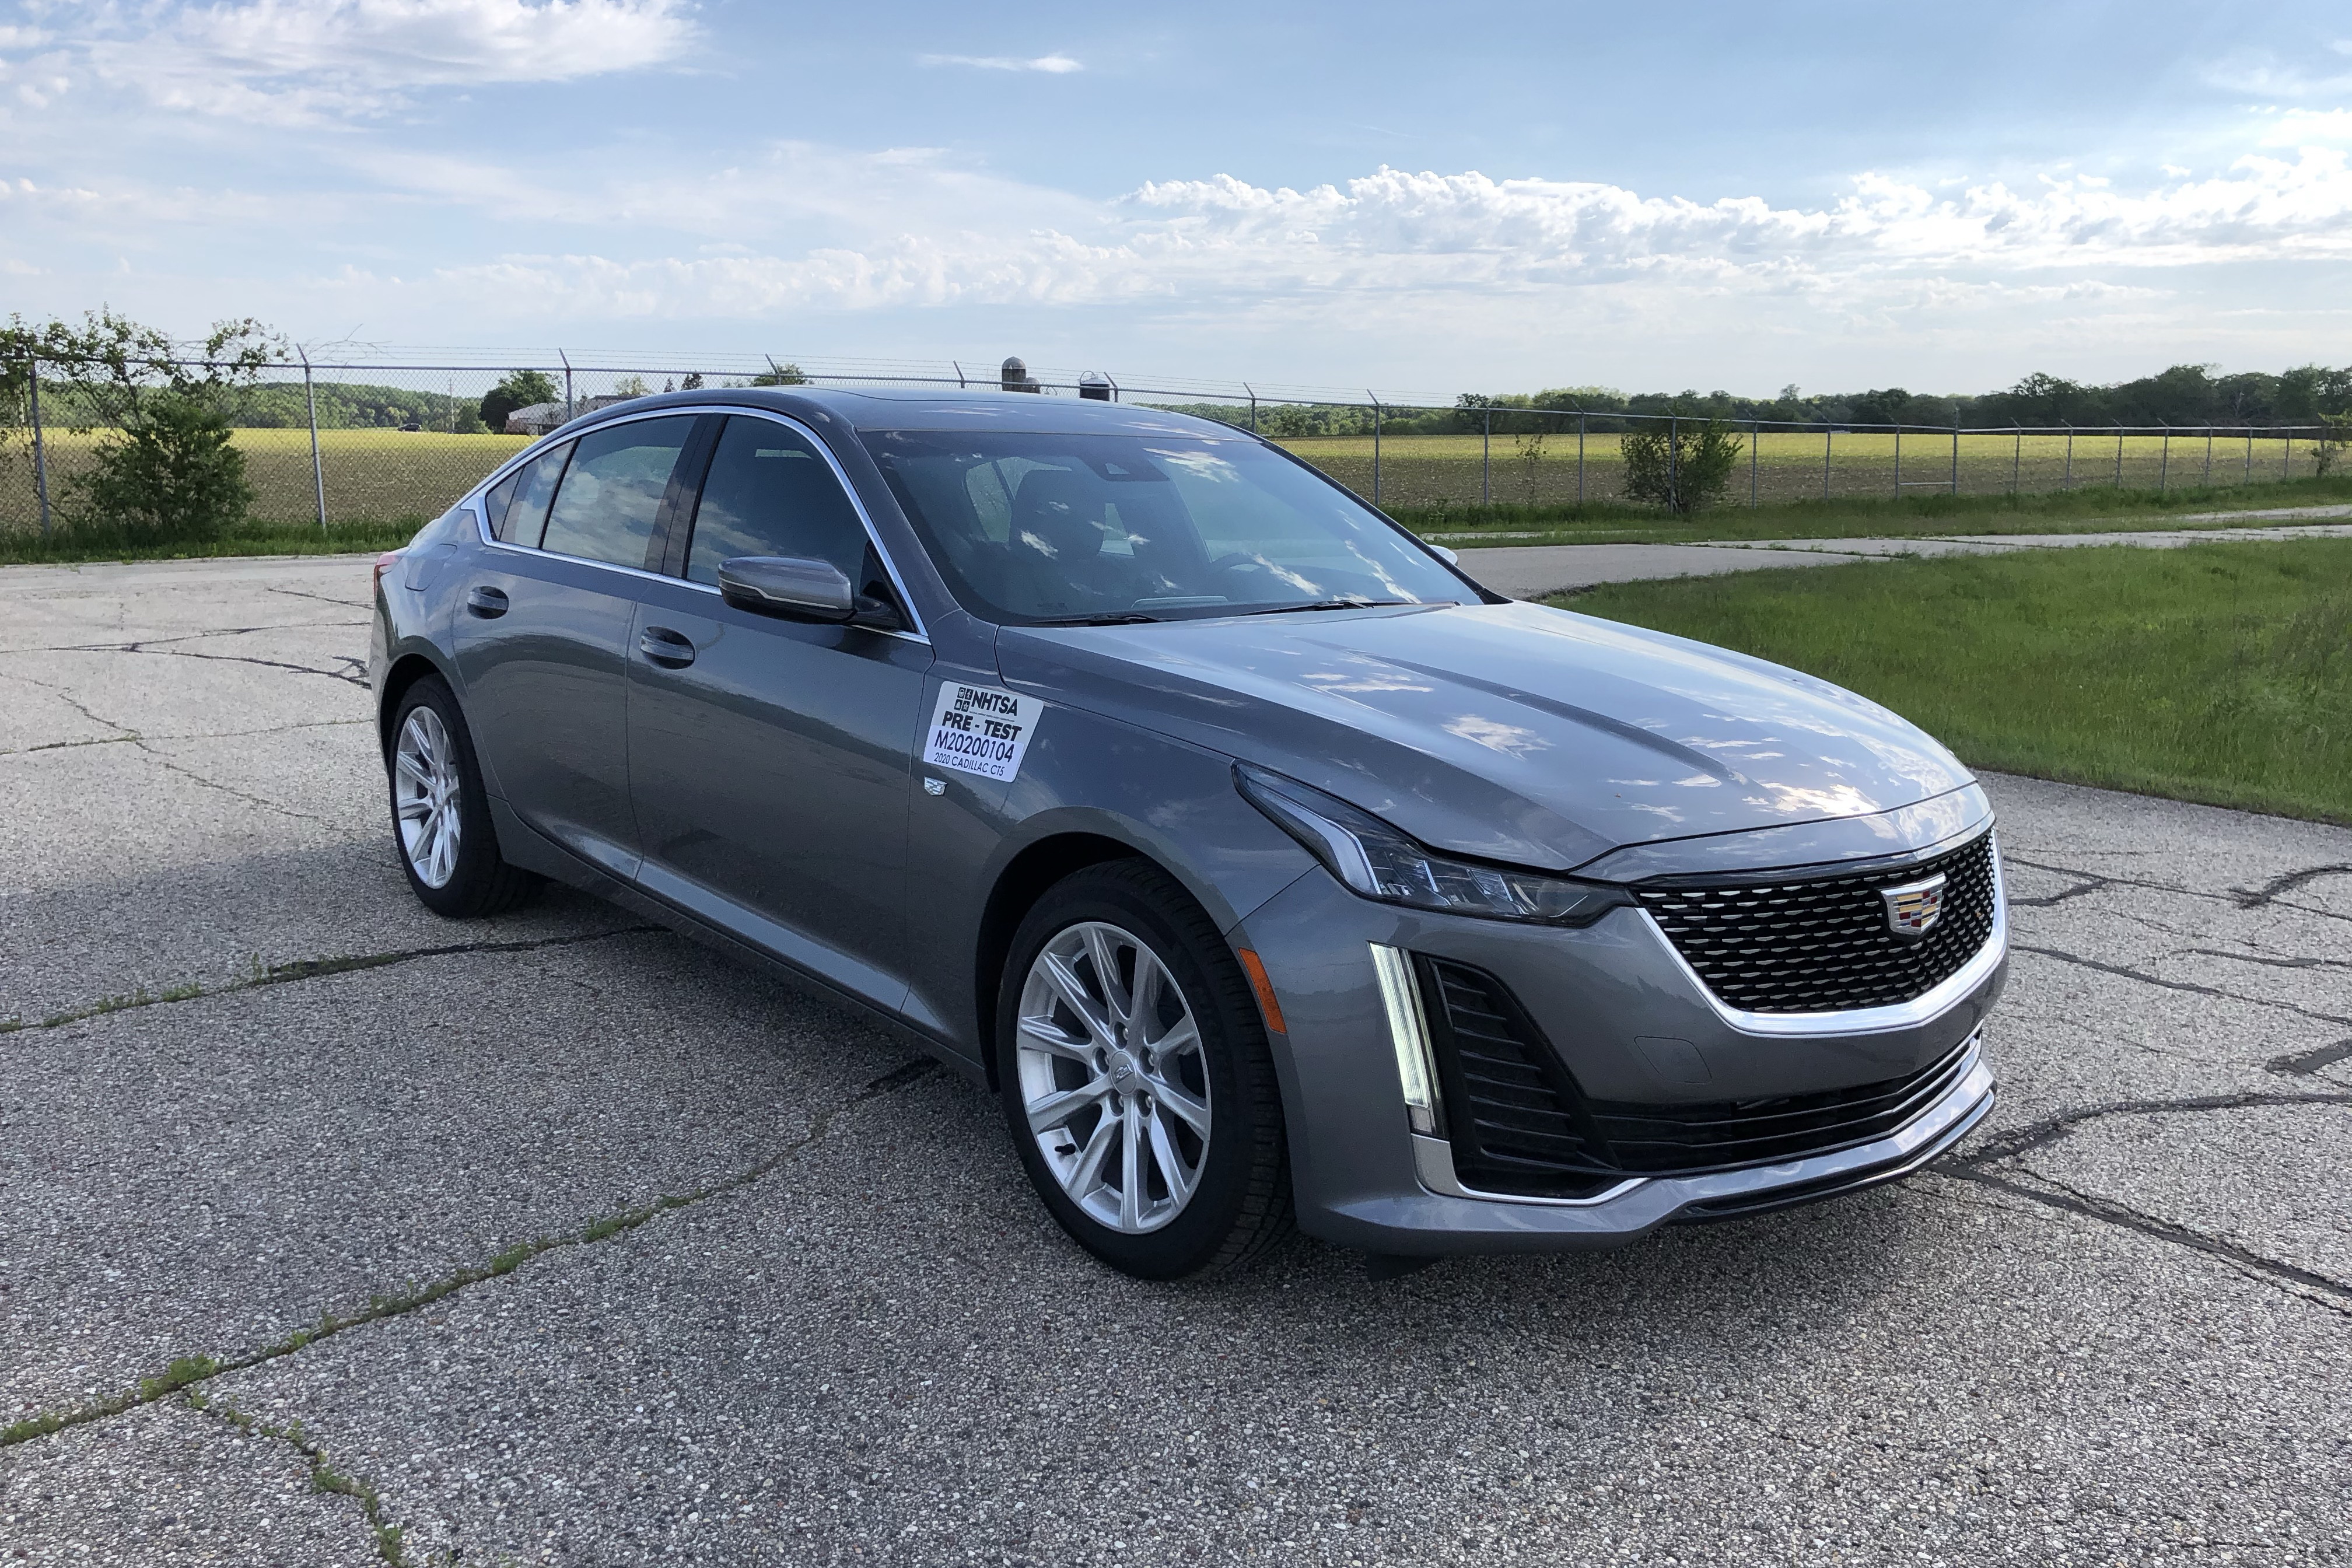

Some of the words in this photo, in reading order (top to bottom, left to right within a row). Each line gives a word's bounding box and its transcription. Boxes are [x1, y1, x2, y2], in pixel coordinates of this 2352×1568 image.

[971, 690, 1017, 716] NHTSA
[942, 710, 973, 732] PRE
[984, 719, 1022, 741] TEST
[935, 730, 1014, 762] M20200104
[934, 752, 950, 764] 2020
[951, 756, 989, 772] CADILLAC
[991, 765, 1005, 776] CT5
